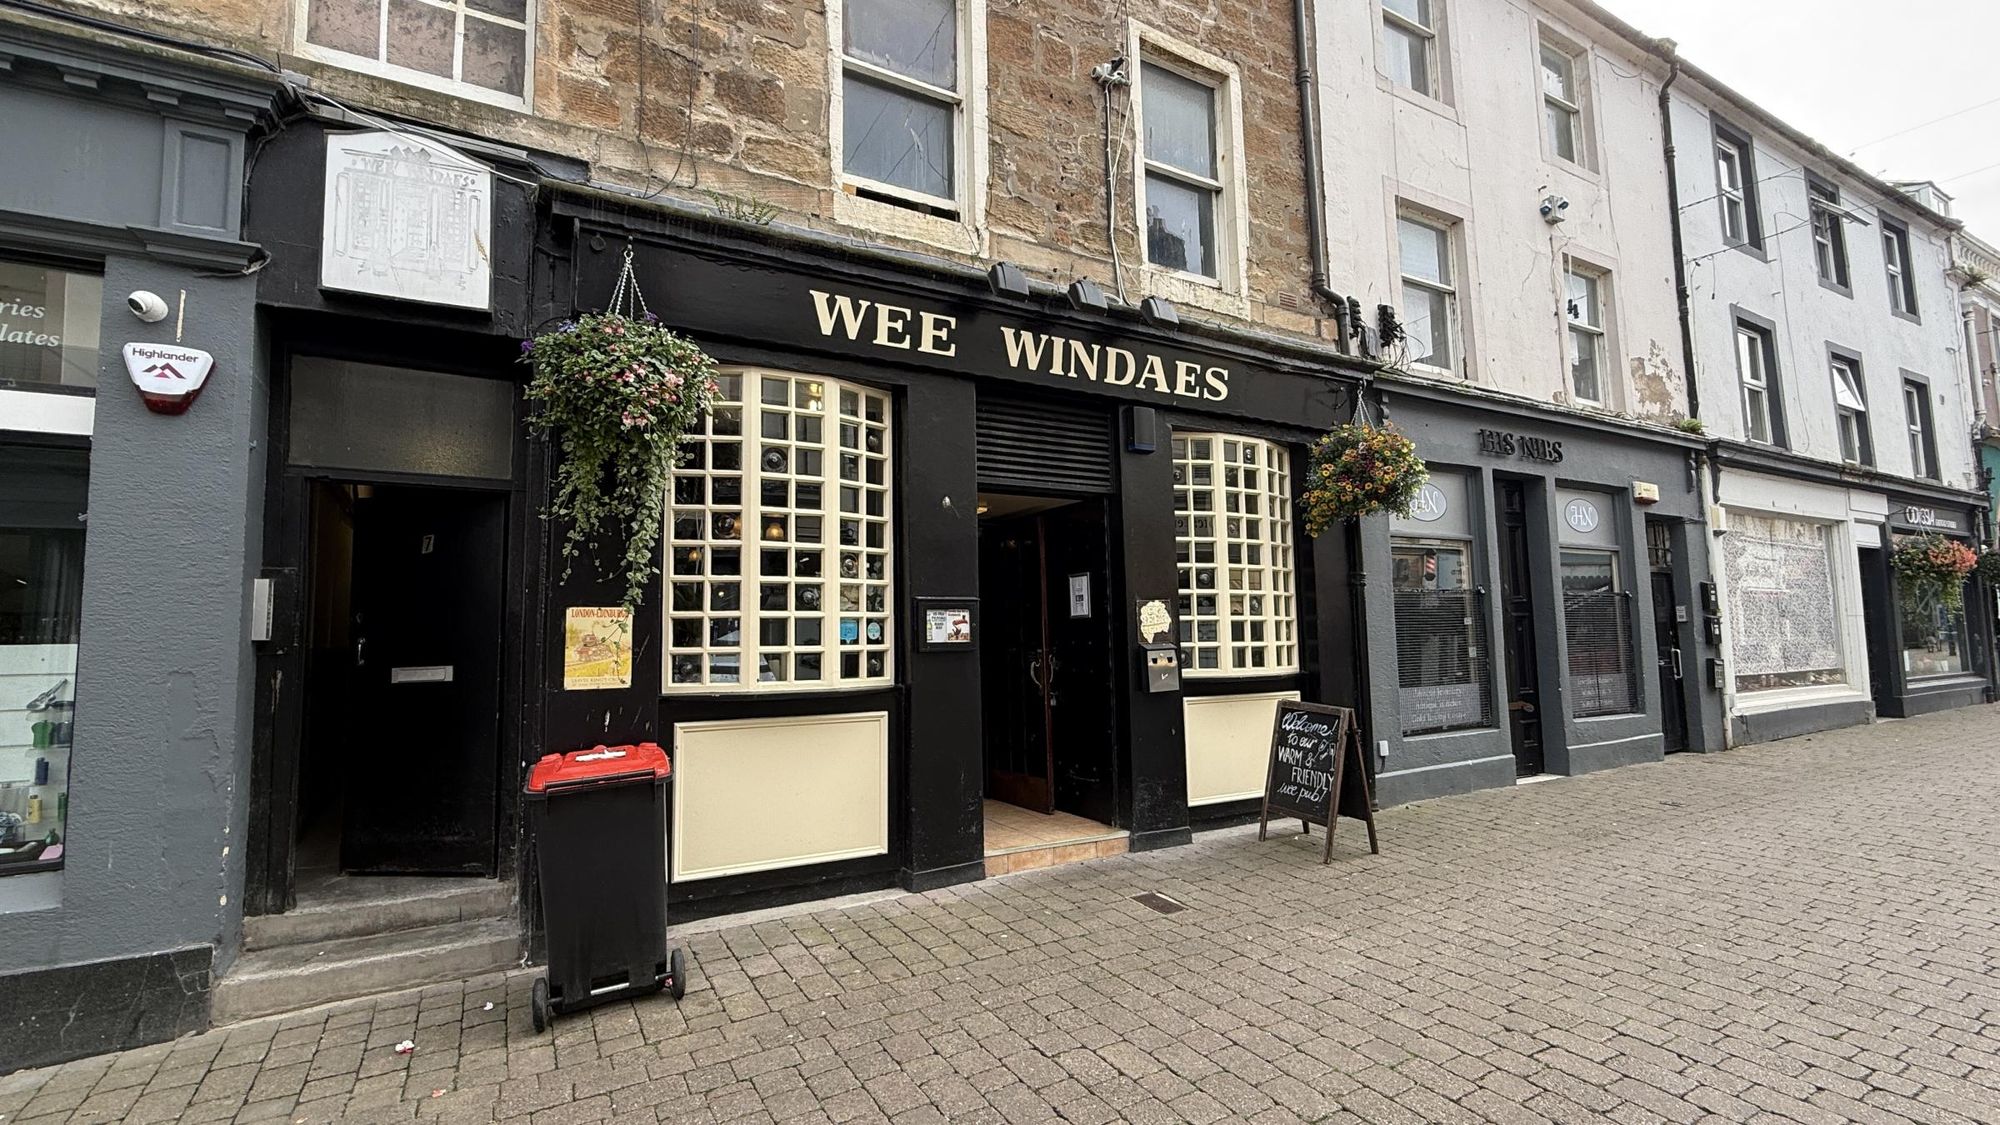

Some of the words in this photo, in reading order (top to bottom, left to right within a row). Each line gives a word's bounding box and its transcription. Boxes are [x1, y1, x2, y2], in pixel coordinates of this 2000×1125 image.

[132, 347, 199, 364] Highlander
[809, 289, 957, 358] WEE
[1000, 326, 1230, 401] WINDAES
[1478, 429, 1516, 456] HIS
[1518, 436, 1564, 464] NIBS
[1282, 711, 1338, 736] Welcome!
[1287, 730, 1298, 746] to
[1299, 736, 1318, 748] our
[1278, 745, 1303, 766] WARM
[1305, 752, 1315, 768] &
[1291, 766, 1335, 792] FRIENDLY
[1277, 782, 1298, 796] wee
[1296, 788, 1327, 804] pub!
